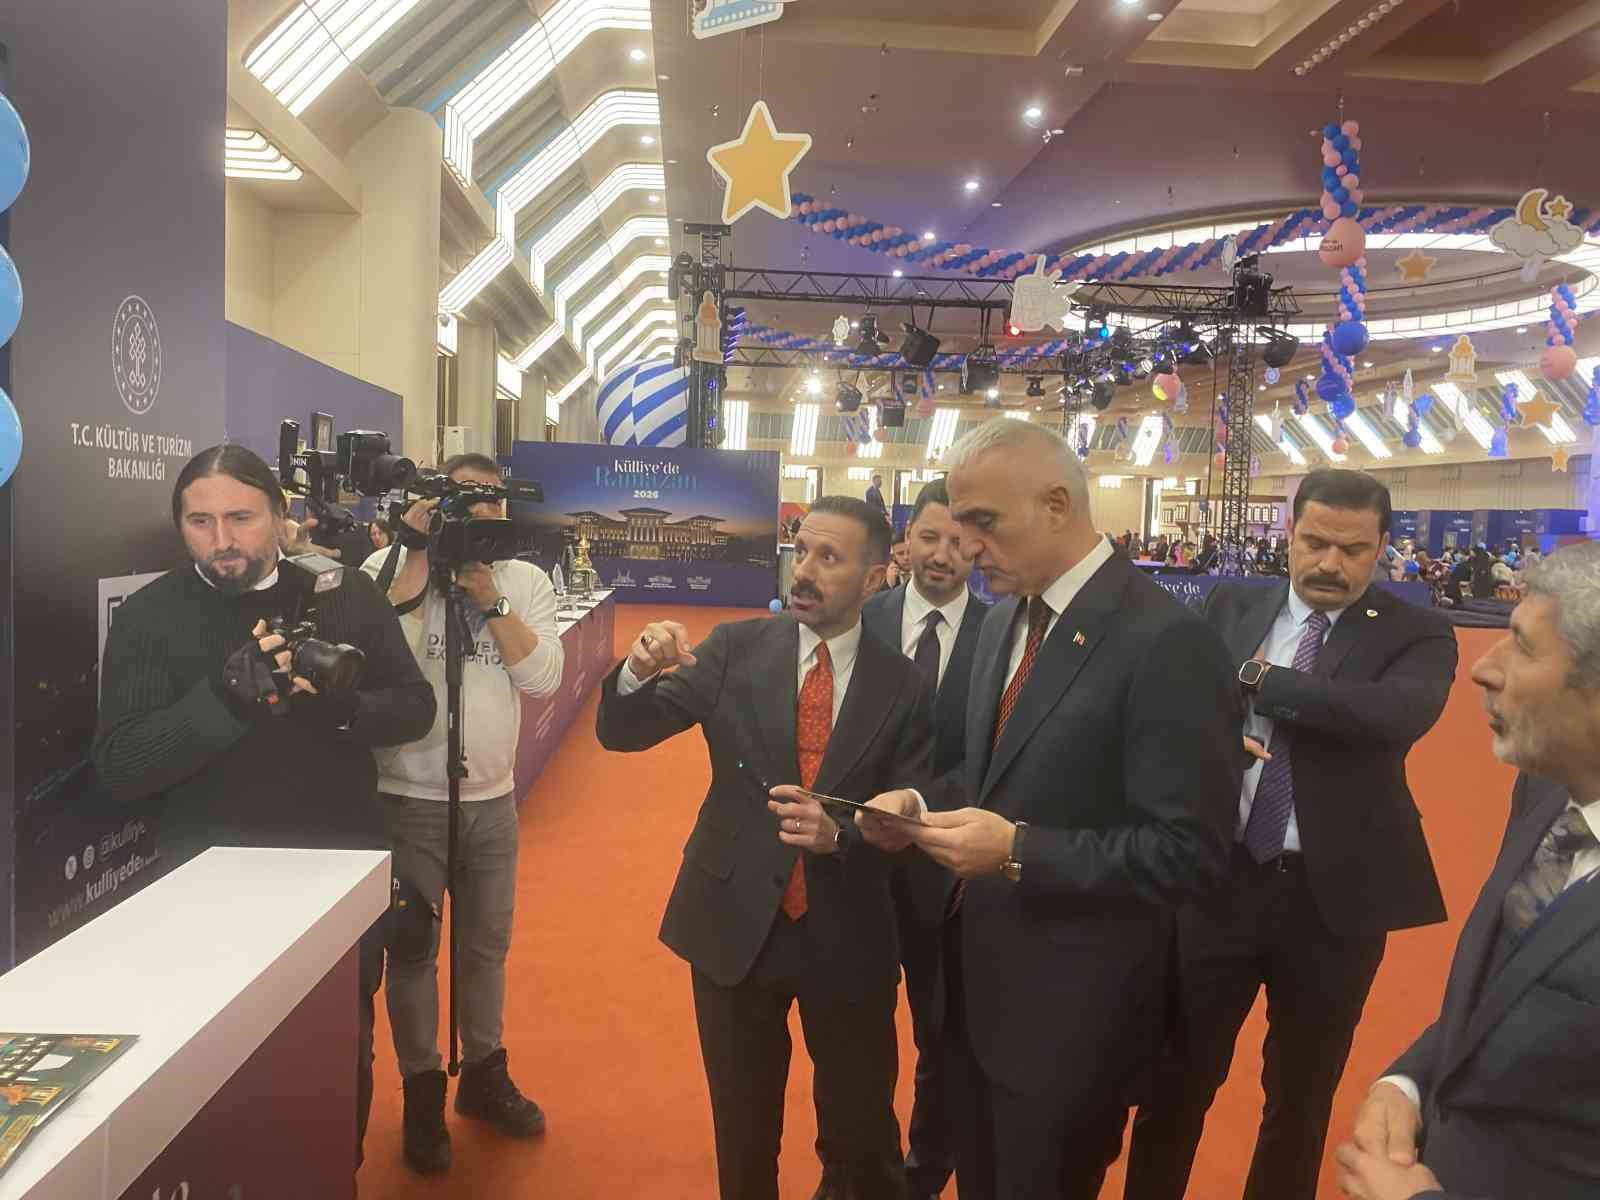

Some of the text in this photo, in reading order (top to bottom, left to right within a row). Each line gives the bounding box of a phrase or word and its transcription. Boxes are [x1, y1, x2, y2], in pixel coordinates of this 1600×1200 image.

[71, 423, 192, 457] T.C. KÜLTÜR VE TURİZM
[108, 457, 165, 480] BAKANLIĞI
